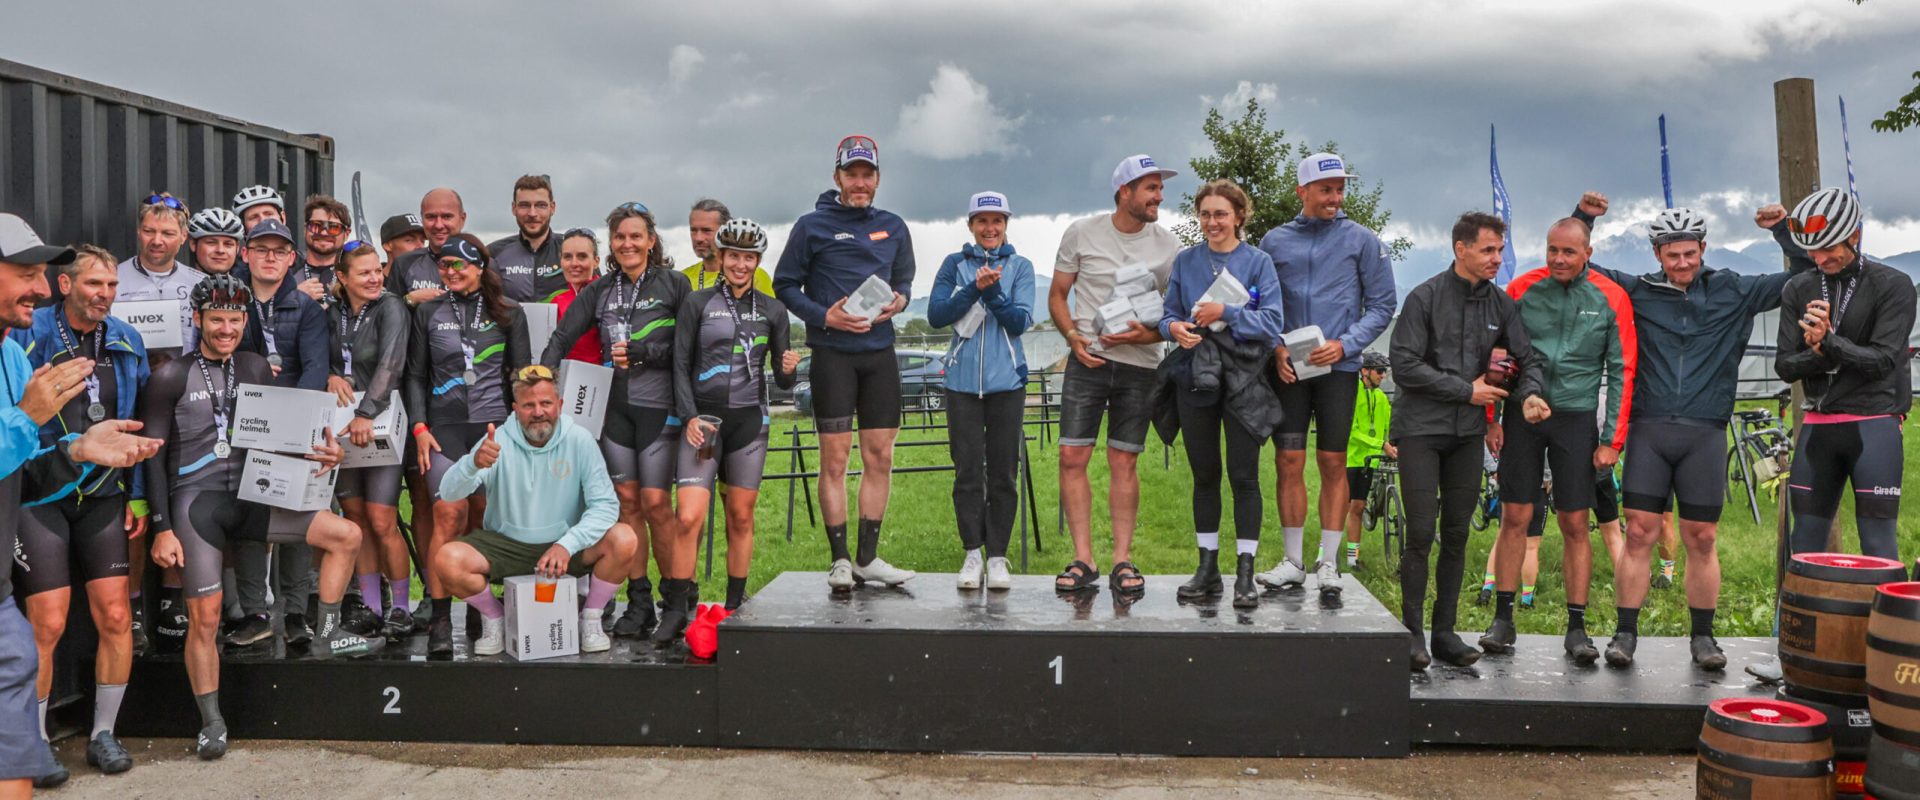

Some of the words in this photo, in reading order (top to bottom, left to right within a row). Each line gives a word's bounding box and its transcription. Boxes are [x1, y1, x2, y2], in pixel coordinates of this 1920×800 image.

[128, 314, 164, 324] uvex
[244, 390, 263, 398] uvex
[574, 384, 587, 415] uvex
[240, 417, 268, 427] cycling
[240, 424, 270, 434] helmets
[252, 457, 272, 466] uvex
[549, 623, 557, 651] cycling
[330, 637, 367, 649] BORA
[1048, 655, 1063, 685] 1
[382, 686, 402, 714] 2
